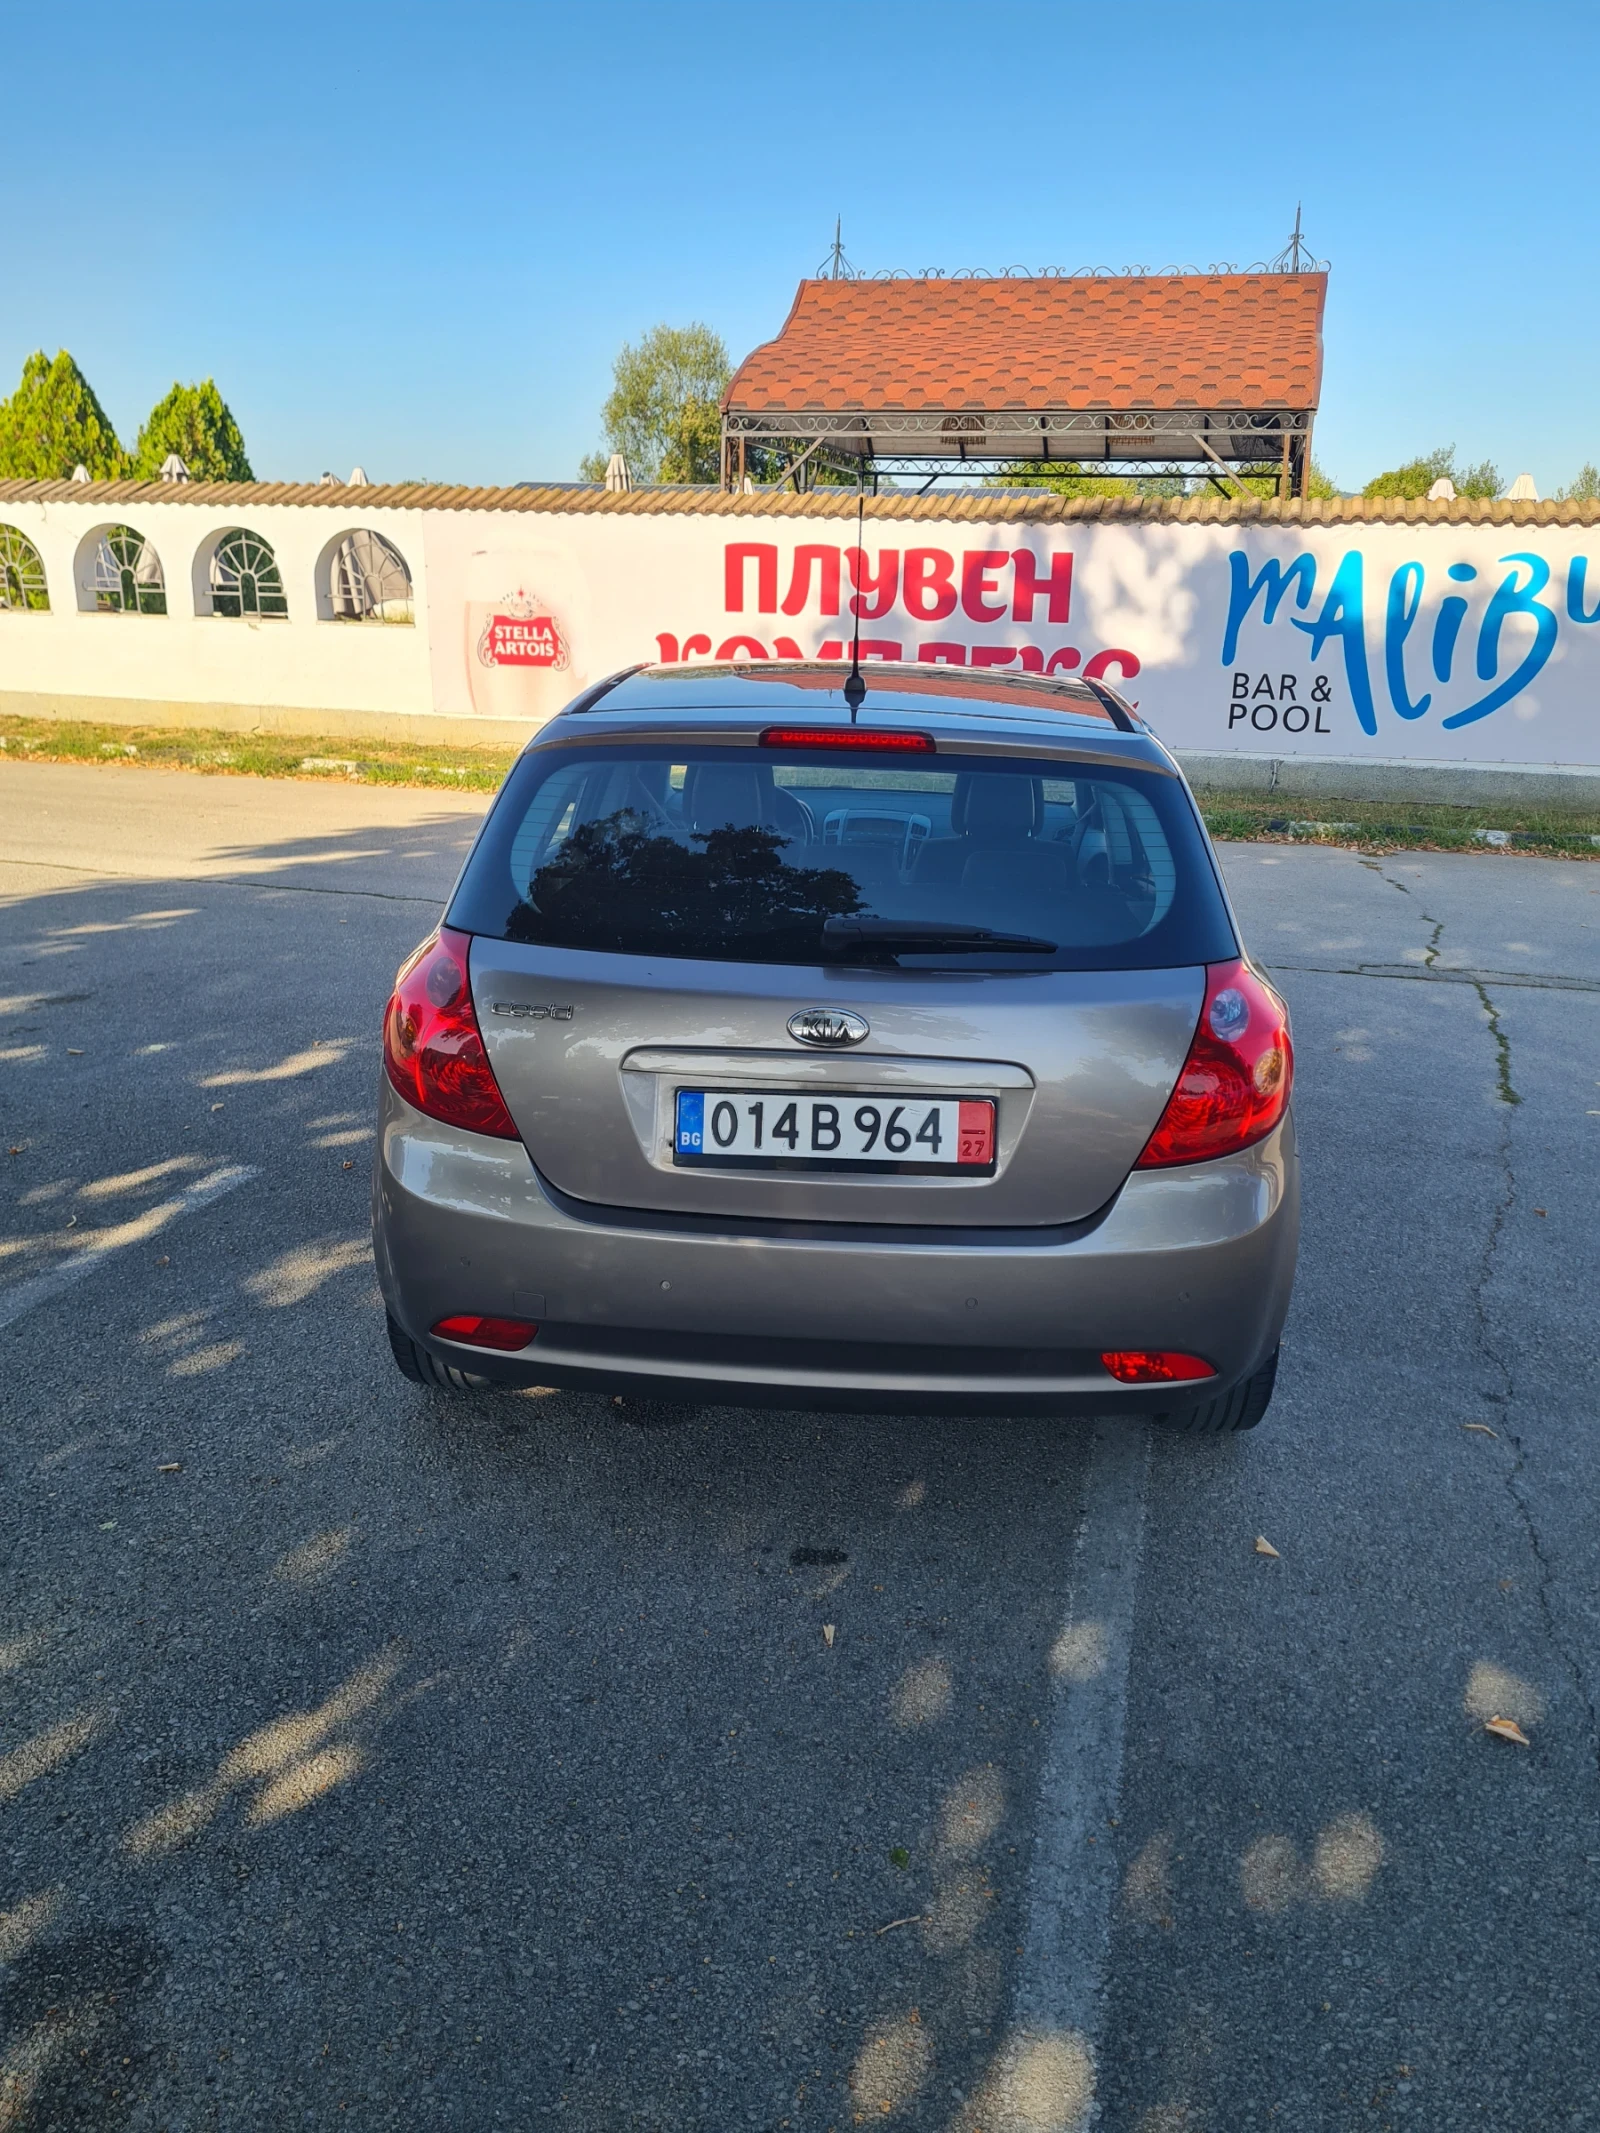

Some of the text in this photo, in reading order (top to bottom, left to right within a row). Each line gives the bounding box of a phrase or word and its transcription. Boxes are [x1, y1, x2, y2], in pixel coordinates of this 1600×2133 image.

[724, 542, 1074, 623] ПЛУВЕН
[494, 625, 553, 641] STELLA
[494, 641, 555, 657] ARTOIS
[1231, 672, 1332, 702] BAR &
[1227, 704, 1331, 733] POOL
[801, 1016, 856, 1040] KIA
[681, 1131, 701, 1147] BG
[962, 1140, 985, 1157] 27
